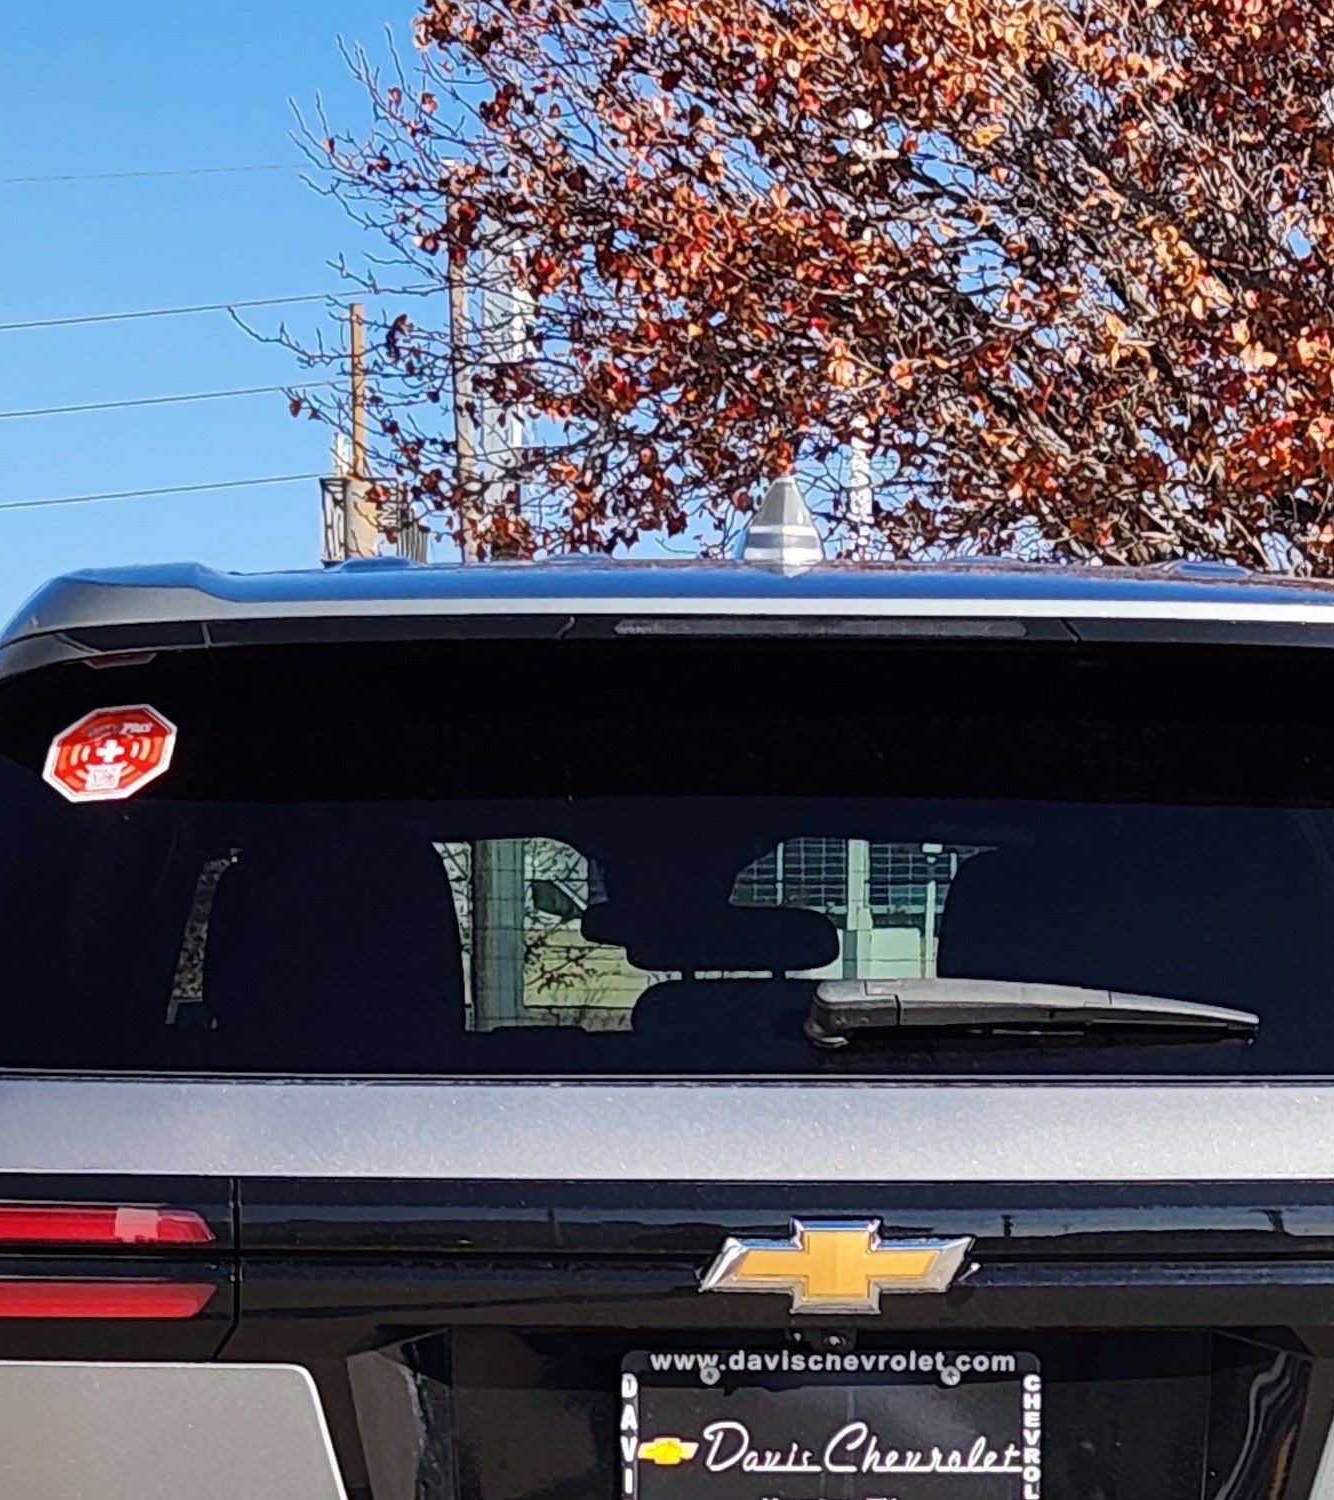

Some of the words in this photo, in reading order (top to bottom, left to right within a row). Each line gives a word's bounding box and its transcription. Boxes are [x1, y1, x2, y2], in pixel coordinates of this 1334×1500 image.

[650, 1349, 1016, 1371] www.davischevroletcom
[702, 1420, 823, 1472] Davis
[823, 1421, 1023, 1473] Chevrolet
